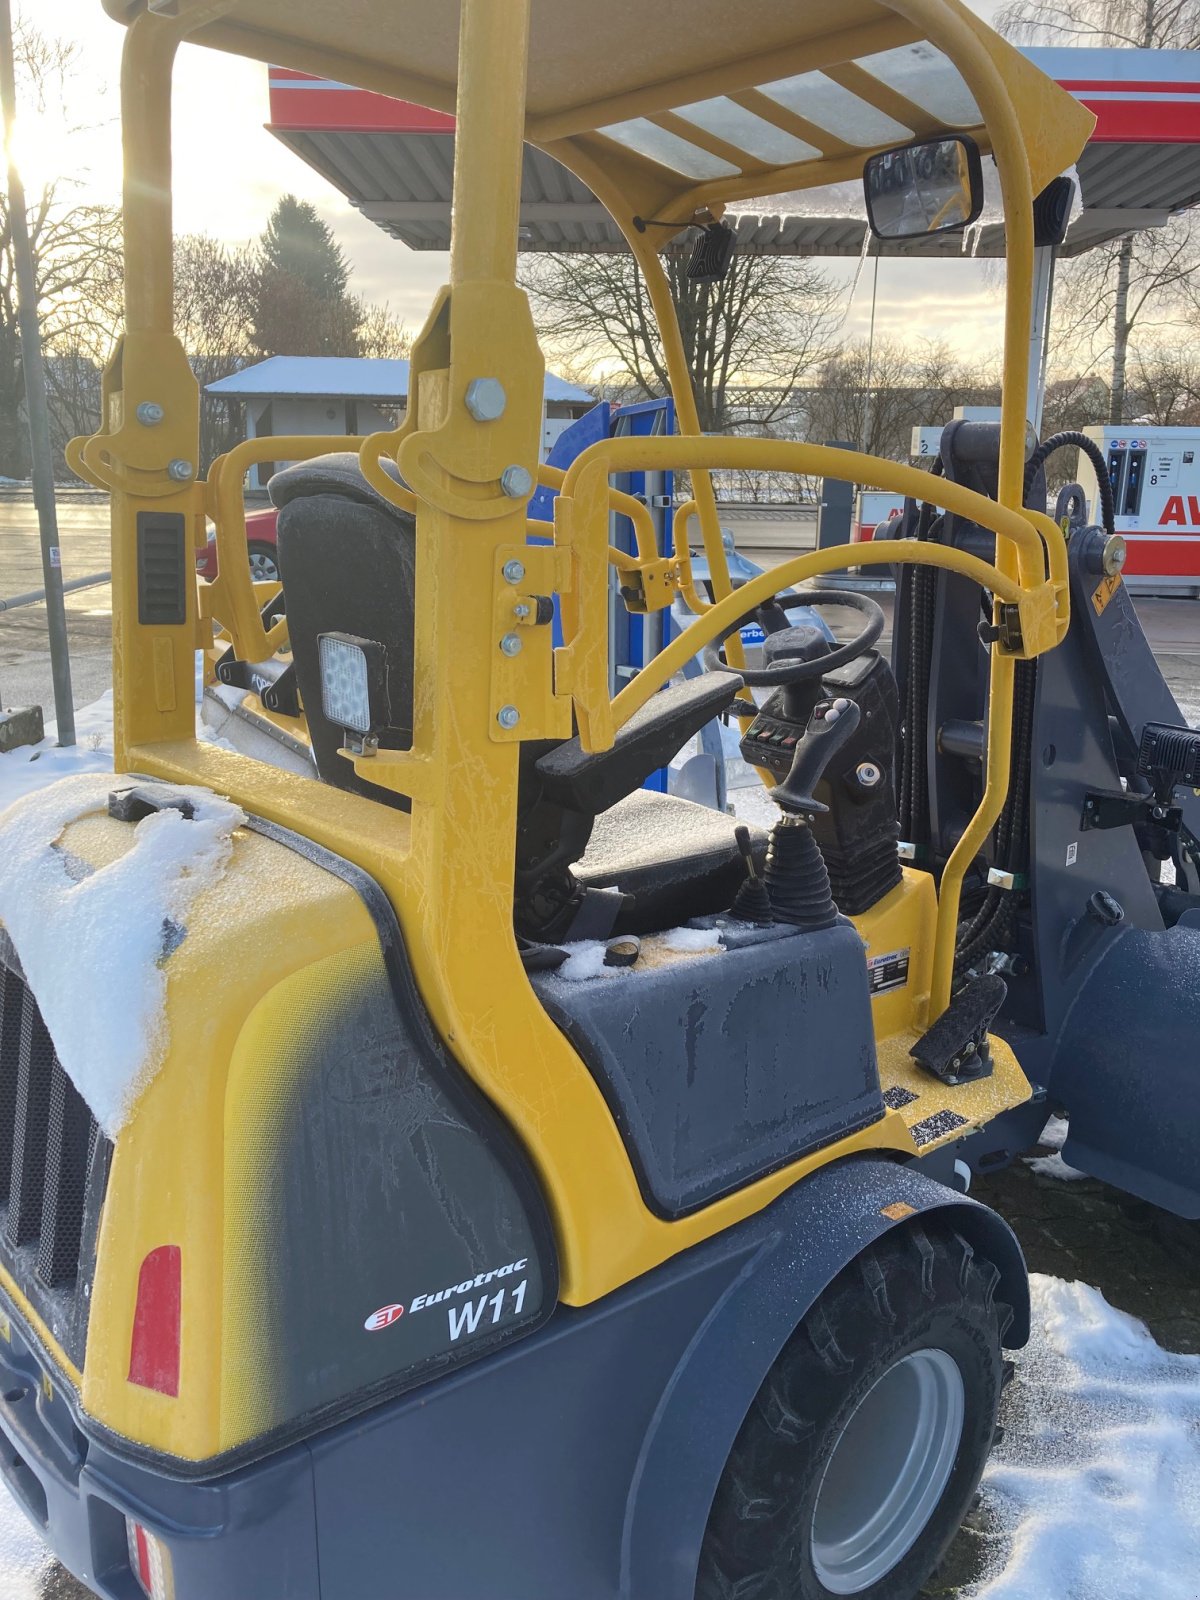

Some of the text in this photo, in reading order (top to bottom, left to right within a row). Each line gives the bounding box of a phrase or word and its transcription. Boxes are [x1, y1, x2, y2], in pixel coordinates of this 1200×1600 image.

[921, 443, 929, 454] 2
[1150, 475, 1158, 485] 8
[409, 1258, 528, 1313] Eurotrac
[448, 1279, 528, 1341] W11
